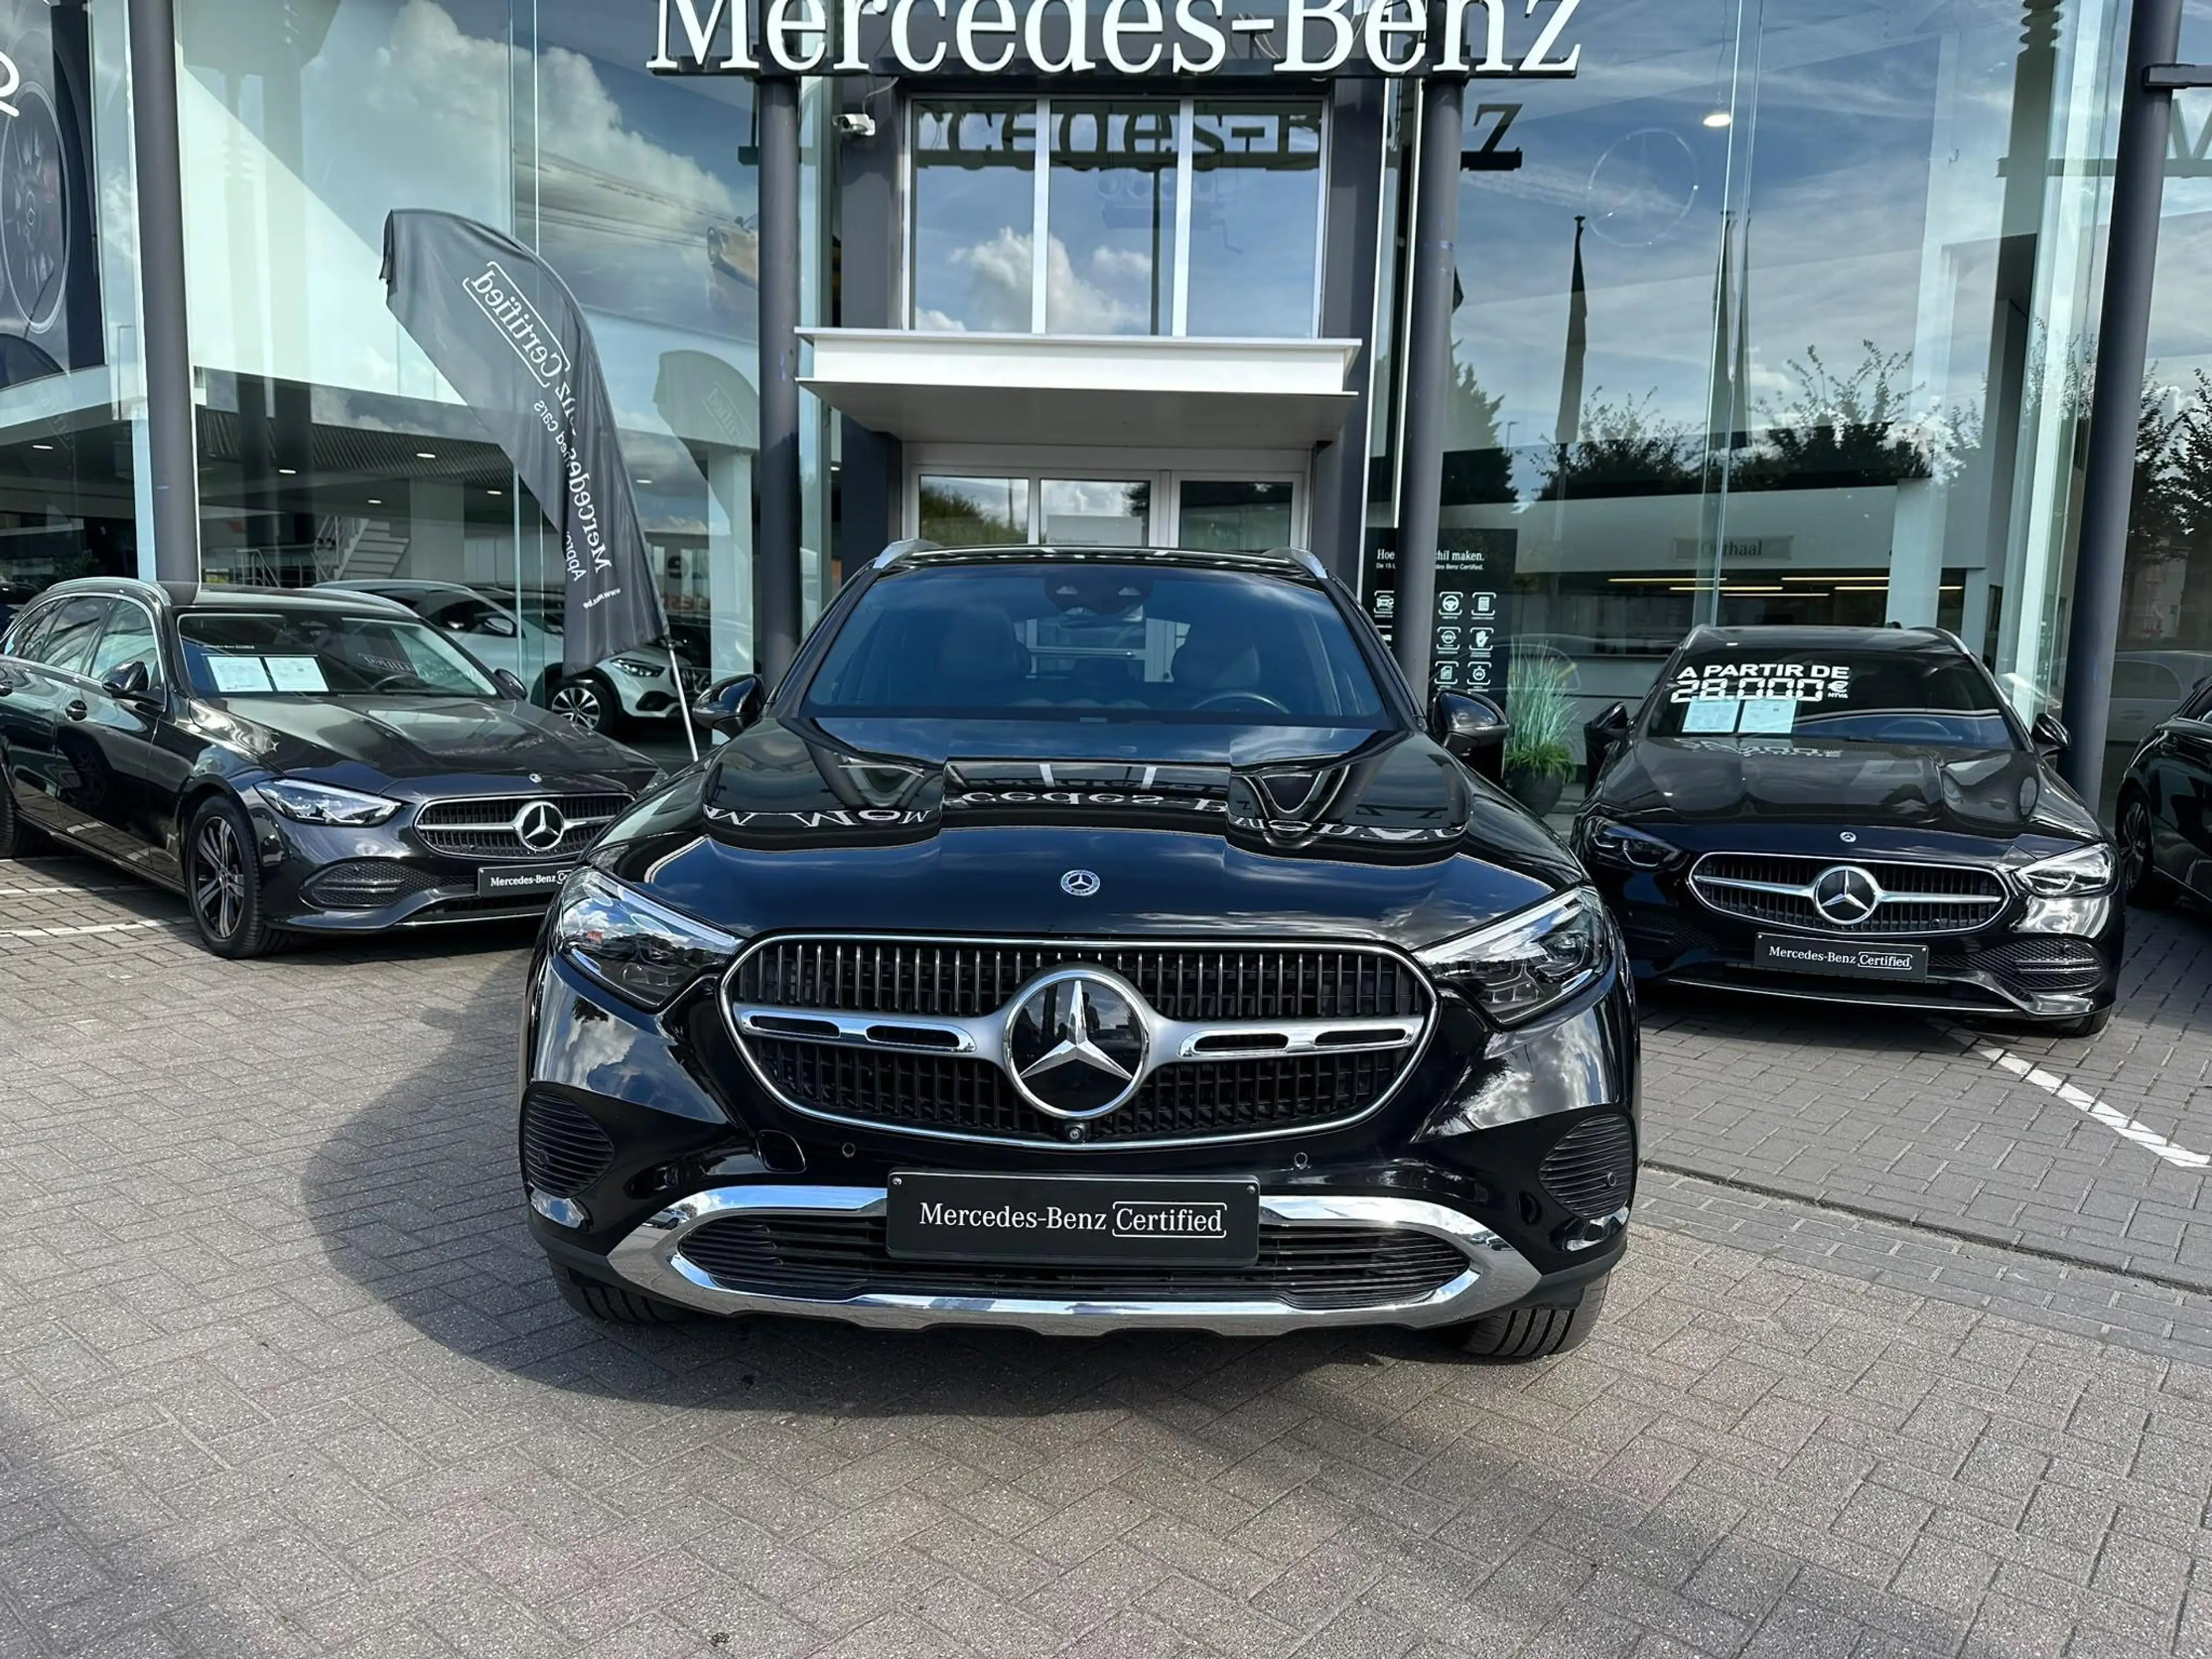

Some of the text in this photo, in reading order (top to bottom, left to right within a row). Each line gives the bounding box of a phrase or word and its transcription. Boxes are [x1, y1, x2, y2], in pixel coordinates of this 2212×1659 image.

[646, 0, 1582, 73] Mercedes-Benz
[1377, 549, 1395, 560] Hoe
[1452, 551, 1485, 561] maken.
[1677, 664, 1850, 679] A PARTIR DE
[490, 874, 556, 887] Mercedes-Benz
[1769, 946, 1910, 968] Mercedes-Benz Certified
[919, 1202, 1222, 1232] Mercedes-Benz Certified
